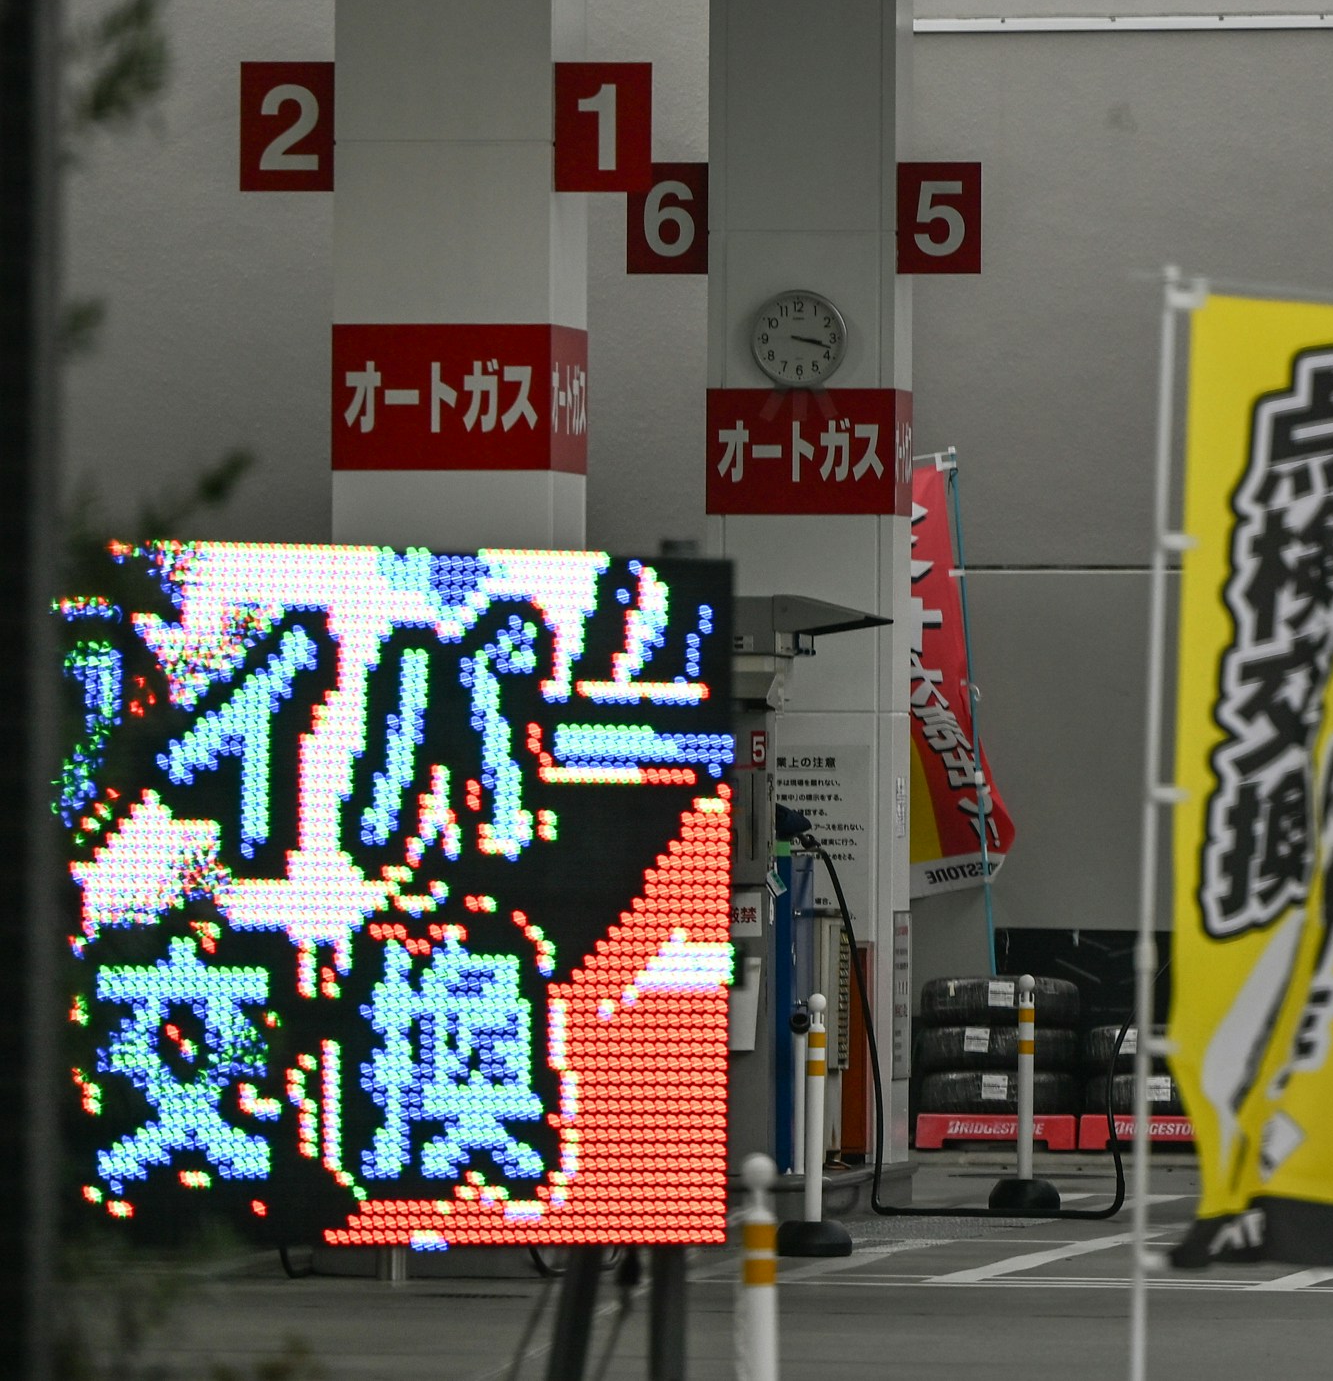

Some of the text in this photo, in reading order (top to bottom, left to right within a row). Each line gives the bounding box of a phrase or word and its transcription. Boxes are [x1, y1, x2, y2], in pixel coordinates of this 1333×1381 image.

[259, 84, 320, 171] 2
[577, 84, 617, 171] 1
[643, 180, 696, 256] 6
[913, 180, 967, 257] 5
[779, 306, 788, 317] 11
[793, 301, 804, 313] 12
[768, 318, 779, 329] 10
[823, 318, 831, 328] 2
[761, 333, 769, 344] 9
[829, 333, 837, 344] 3
[767, 350, 775, 361] 8
[823, 350, 830, 360] 4
[781, 361, 788, 372] 7
[796, 365, 803, 376] 6
[812, 361, 819, 372] 5
[343, 358, 539, 434] オートガス
[717, 419, 885, 483] オートガス
[752, 736, 765, 763] 5
[97, 936, 545, 1180] 交換
[947, 1121, 1044, 1135] BRIDGESTE
[1115, 1121, 1195, 1136] BRGESTO
